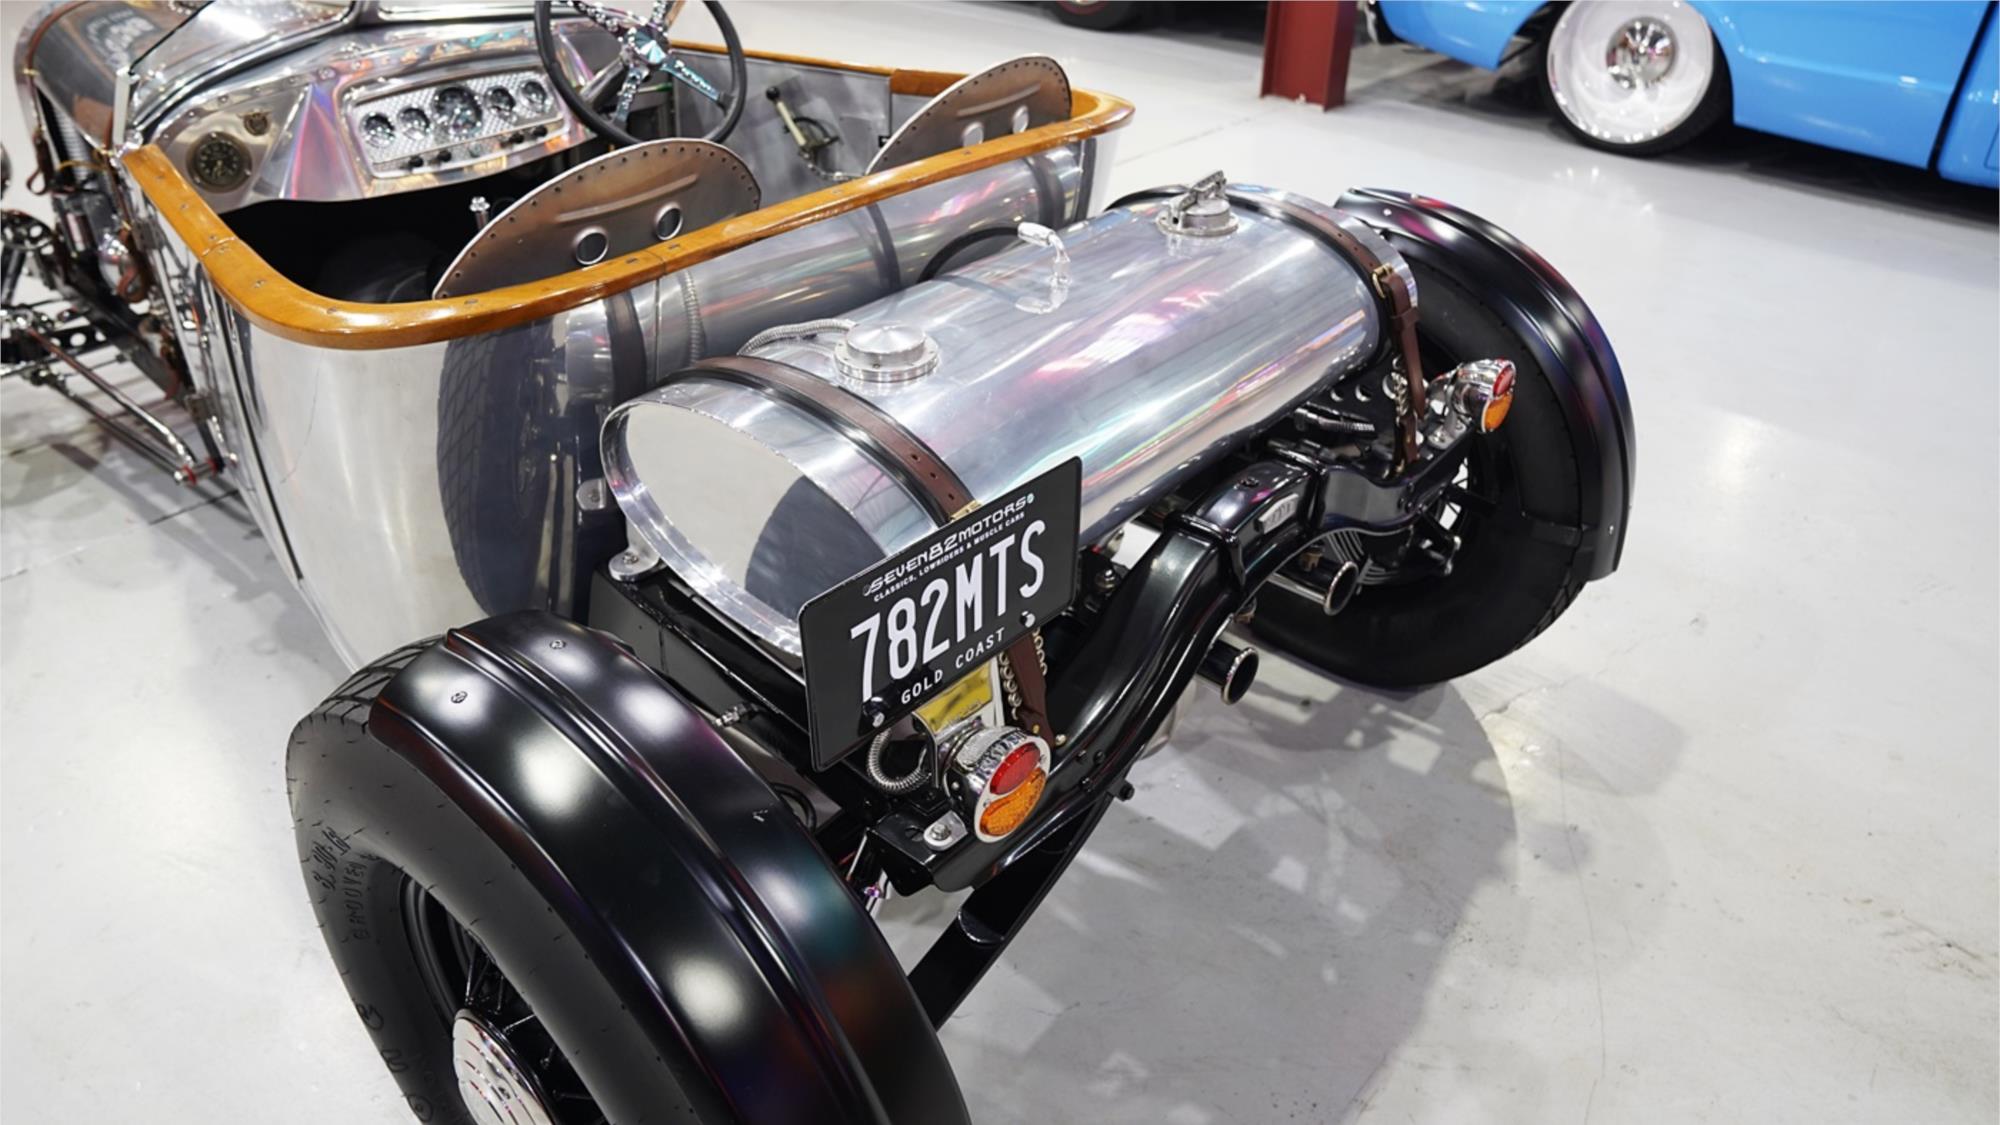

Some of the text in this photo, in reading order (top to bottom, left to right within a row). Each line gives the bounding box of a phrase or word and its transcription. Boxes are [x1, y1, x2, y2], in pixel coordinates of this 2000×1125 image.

[973, 524, 1004, 545] MUSCLE
[1005, 511, 1026, 528] CARS
[850, 520, 1046, 703] 782MTS
[901, 627, 1005, 705] GOLD COAST
